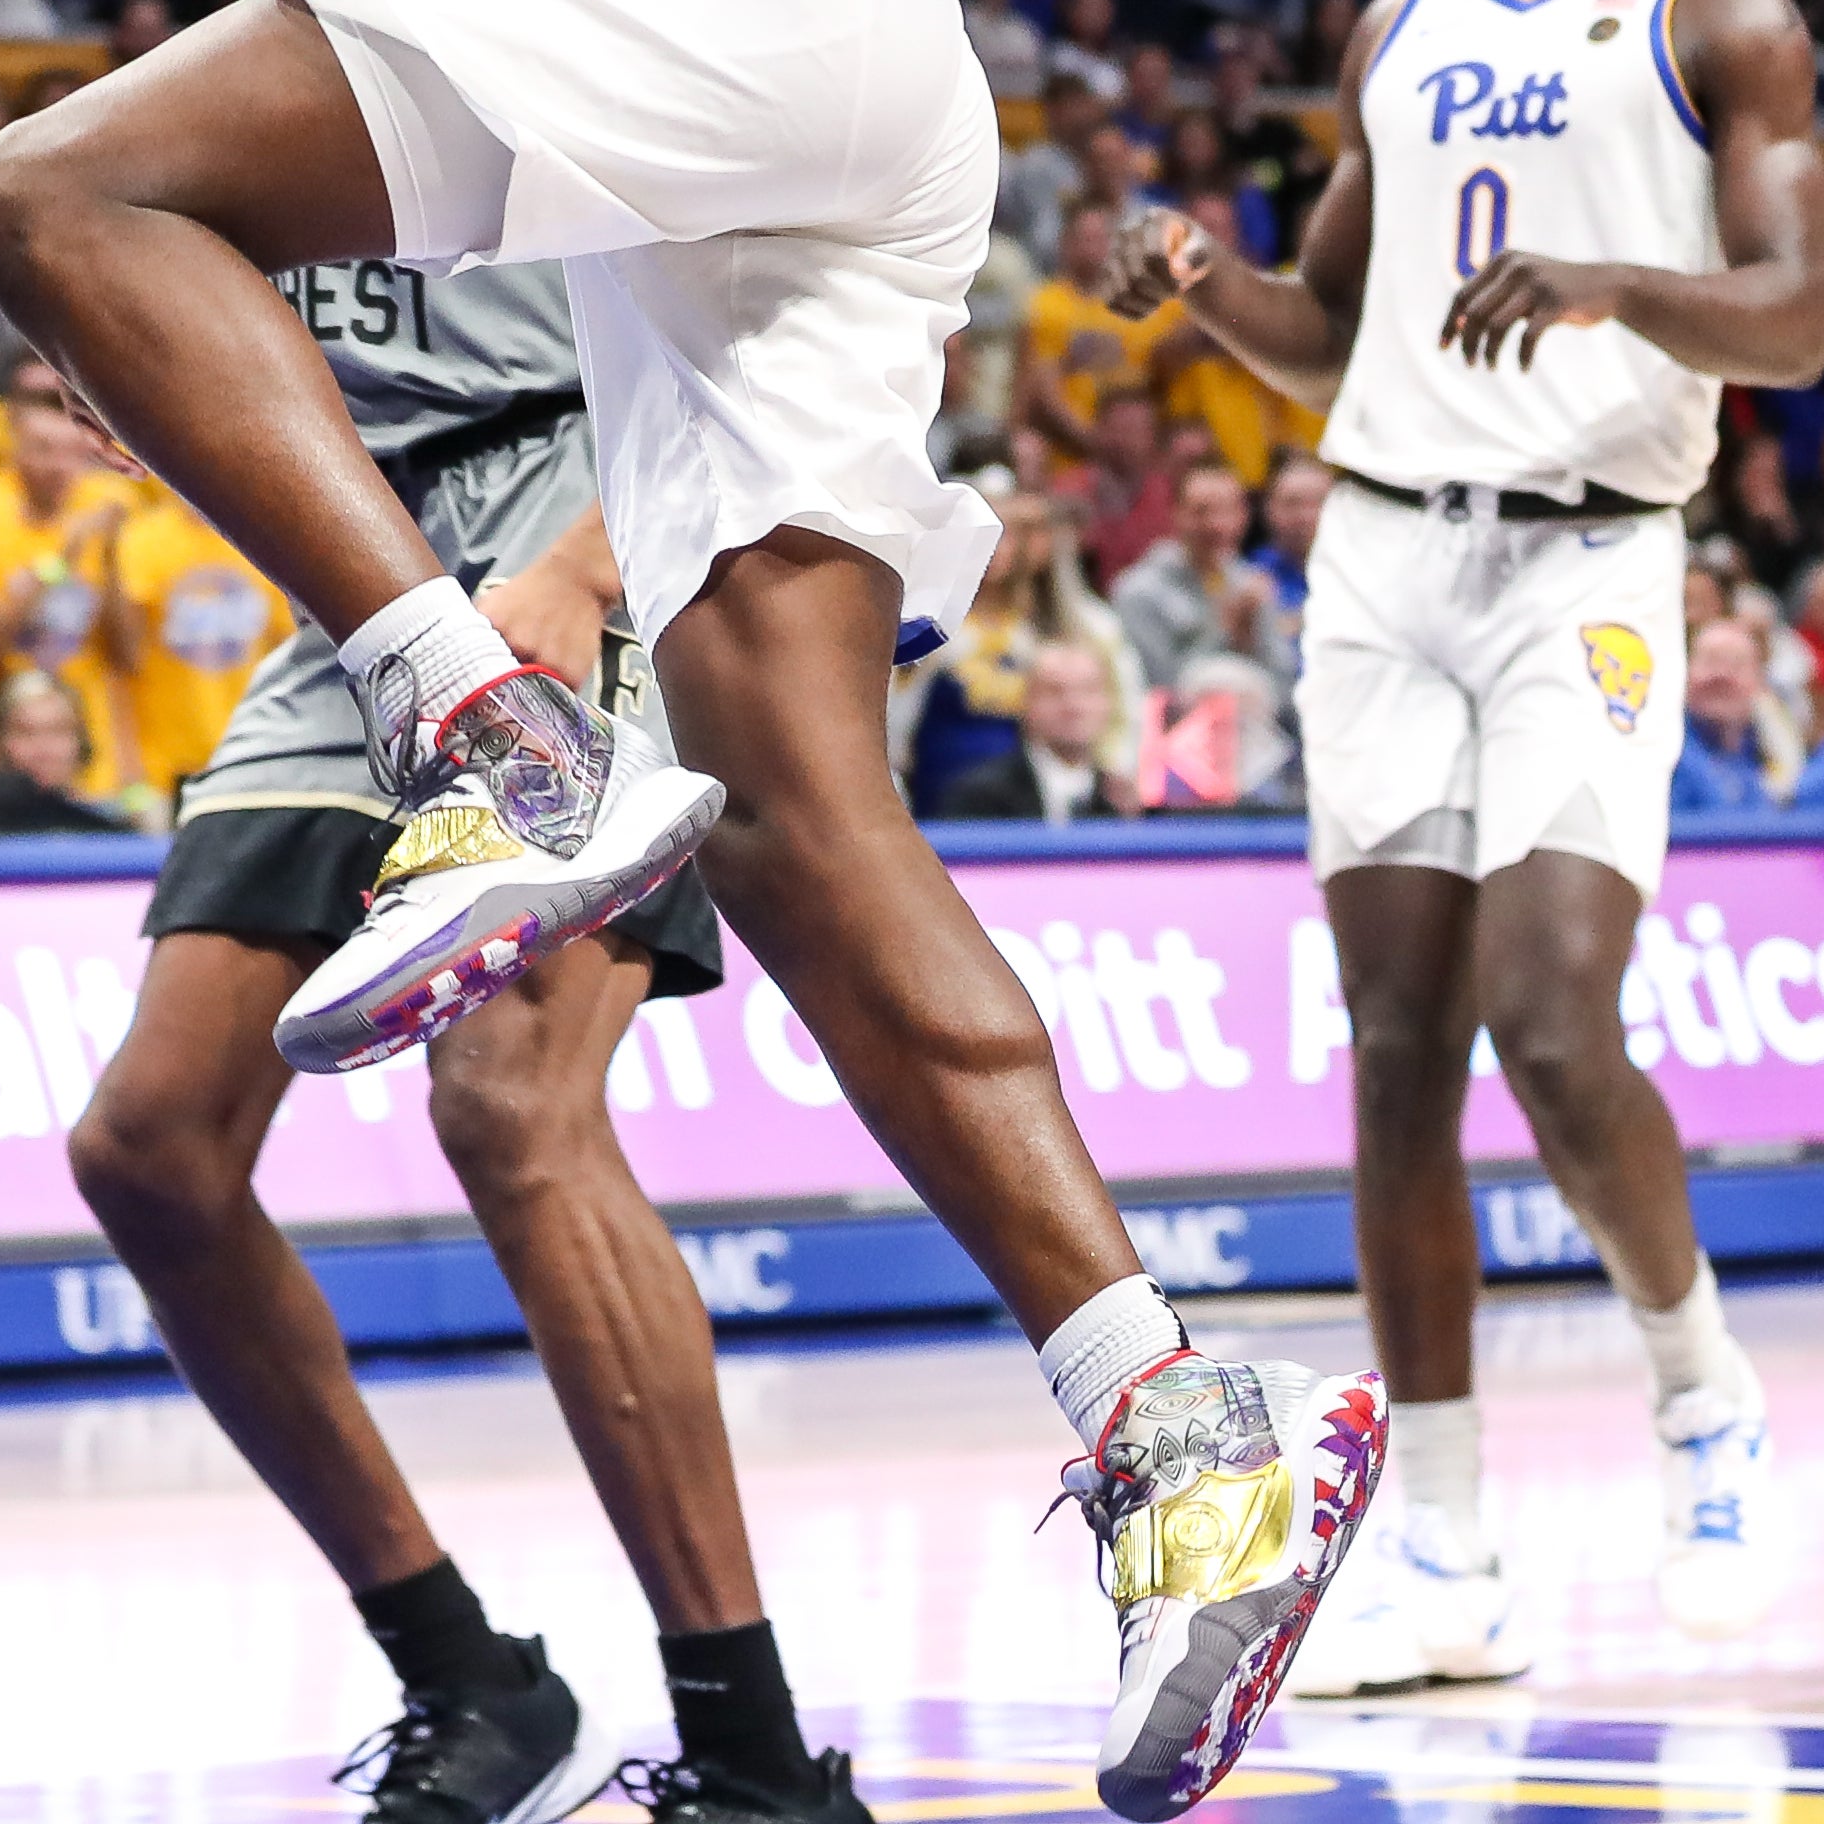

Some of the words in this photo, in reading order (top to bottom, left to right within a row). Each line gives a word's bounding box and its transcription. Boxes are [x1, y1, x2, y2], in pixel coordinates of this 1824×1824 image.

[1418, 61, 1570, 146] Pitt
[1454, 166, 1512, 280] 0
[680, 1229, 794, 1314] MC
[1146, 1206, 1252, 1288] MC
[52, 1266, 164, 1356] UP
